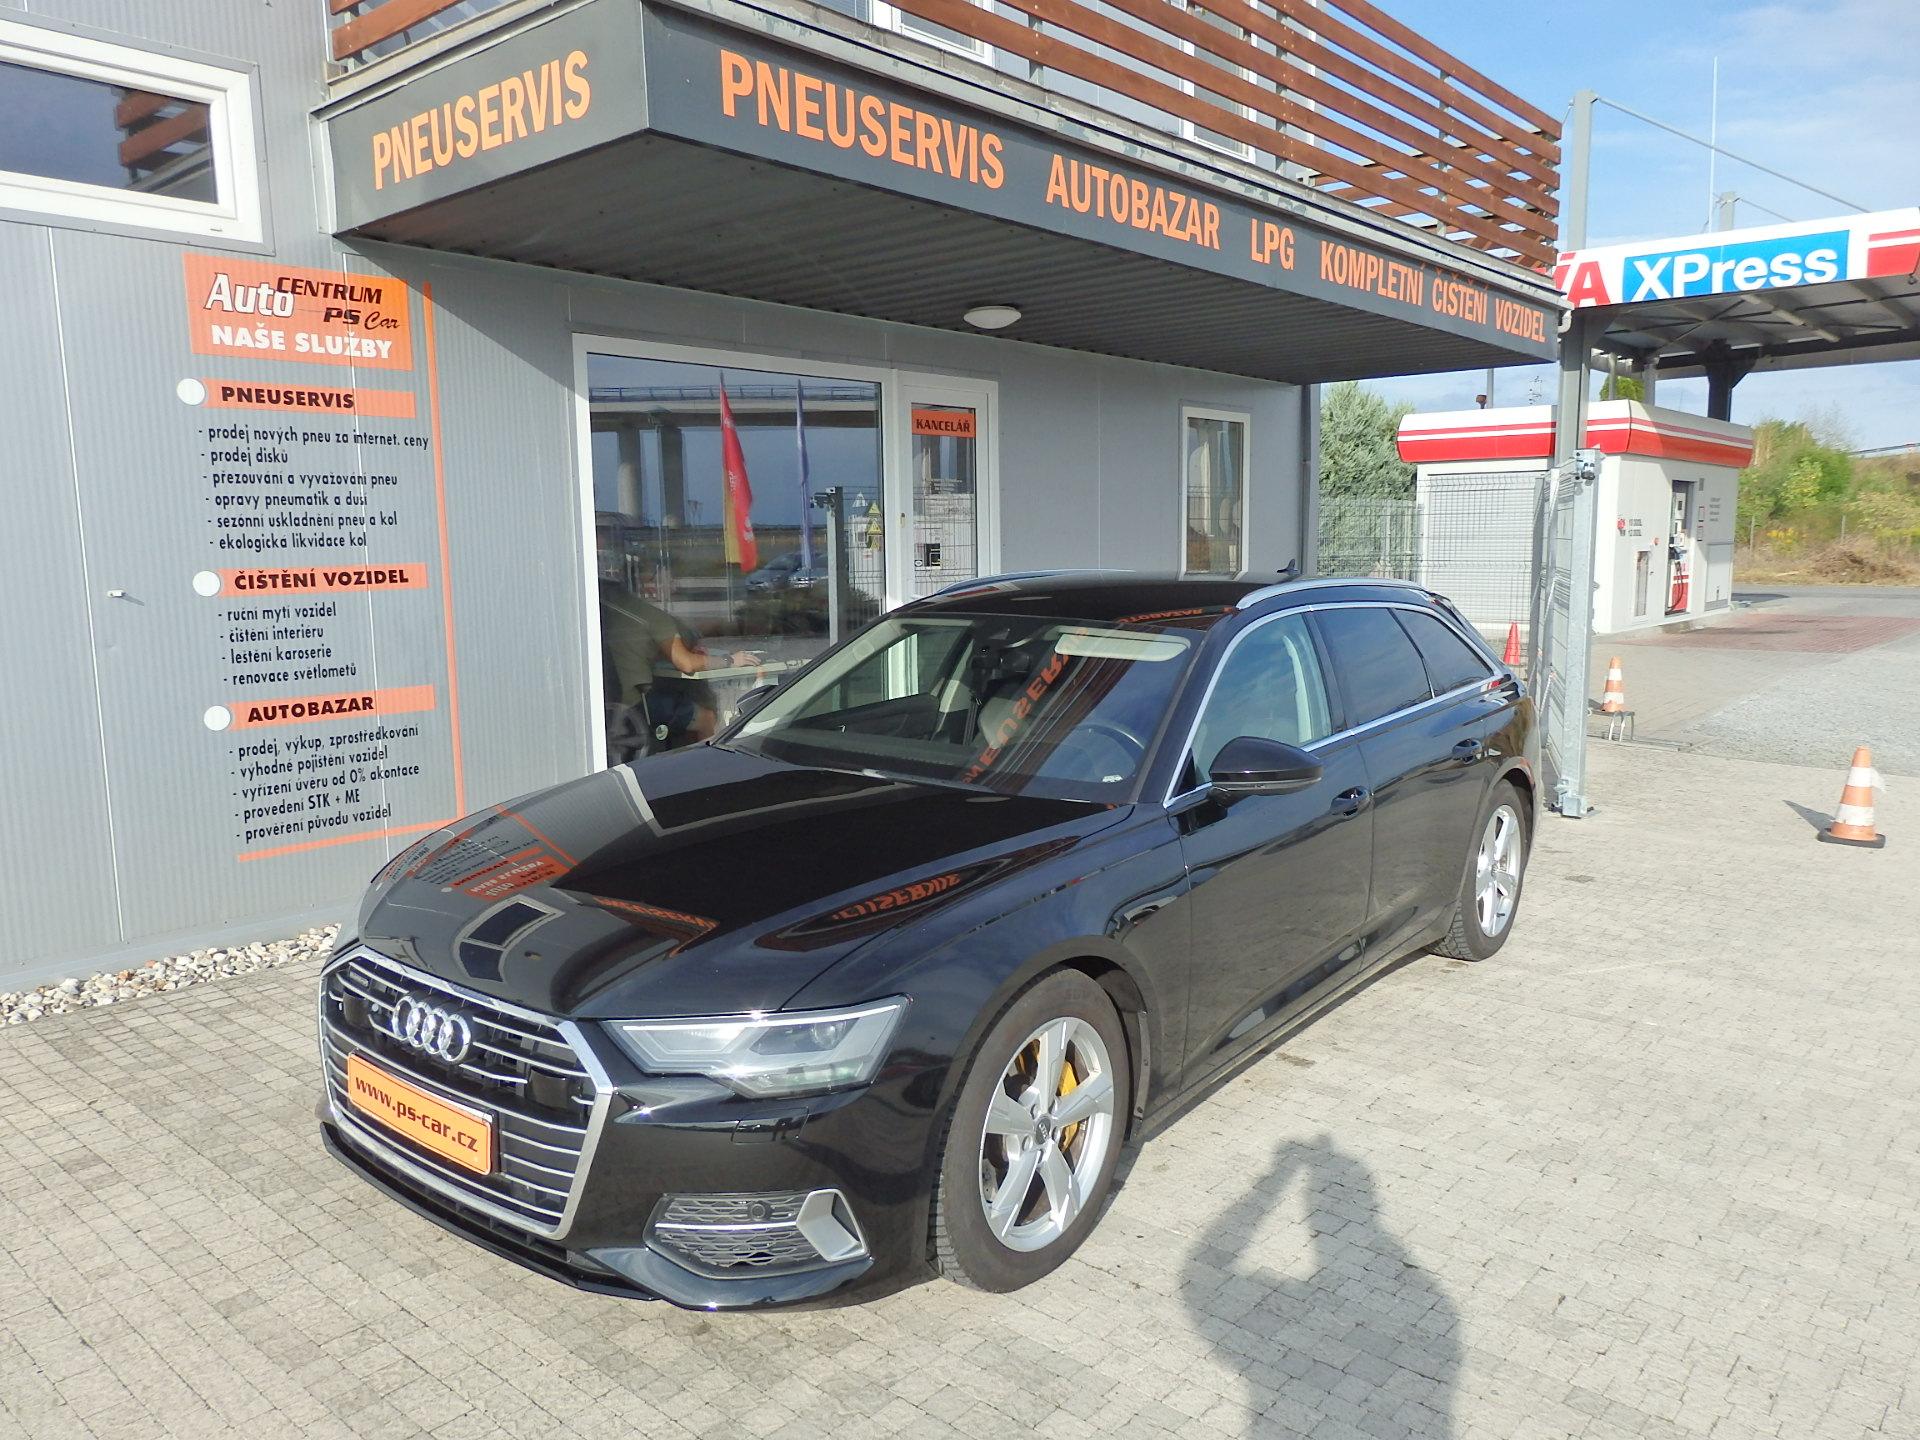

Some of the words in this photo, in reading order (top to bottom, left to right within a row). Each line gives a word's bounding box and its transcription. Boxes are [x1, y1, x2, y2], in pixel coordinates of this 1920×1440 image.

[373, 50, 591, 190] PNEUSERVIS
[720, 49, 1004, 189] PNEUSERVIS
[1046, 153, 1220, 250] AUTOBAZAR
[1251, 218, 1295, 271] LPG
[1320, 240, 1427, 306] KOMPLETNÍ
[1432, 267, 1489, 325] ČIŠTĚNÍ
[1495, 298, 1546, 343] VOZIDEL
[1629, 248, 1838, 302] XPress
[203, 272, 294, 317] Auto
[277, 277, 382, 304] CENTRUM
[323, 307, 361, 325] PS
[364, 311, 400, 330] Car
[211, 322, 286, 351] NAŠE
[295, 331, 392, 359] SLUŽBY
[221, 386, 355, 408] PNEUSERVIS
[916, 418, 970, 433] KANCELÁŘ
[208, 424, 249, 443] prodej
[254, 426, 298, 444] nových
[302, 430, 331, 445] pneu
[335, 432, 349, 443] za
[353, 429, 400, 446] internet.
[404, 435, 429, 450] ceny
[210, 447, 252, 466] prodej
[287, 474, 294, 484] a
[371, 475, 397, 489] pneu
[215, 495, 260, 510] opravy
[265, 490, 329, 509] pneumatik
[334, 496, 341, 505] a
[338, 516, 365, 529] pneu
[369, 516, 376, 525] a
[380, 510, 397, 525] kol
[219, 533, 287, 552] ekologická
[292, 532, 345, 548] likvidace
[349, 531, 366, 546] kol
[234, 568, 316, 590] ČIŠTĚNÍ
[323, 569, 409, 587] VOZIDEL
[295, 601, 336, 618] vozidel
[276, 643, 332, 660] karoserie
[233, 671, 289, 685] renovace
[248, 697, 374, 722] AUTOBAZAR
[239, 738, 280, 761] prodej,
[349, 745, 388, 763] vozidel
[332, 770, 345, 786] od
[350, 767, 366, 783] 0%
[370, 765, 419, 780] akontace
[308, 793, 331, 810] STK
[345, 788, 360, 804] ME
[353, 803, 391, 822] vozidel
[355, 1076, 478, 1153] www.ps-car.cz
